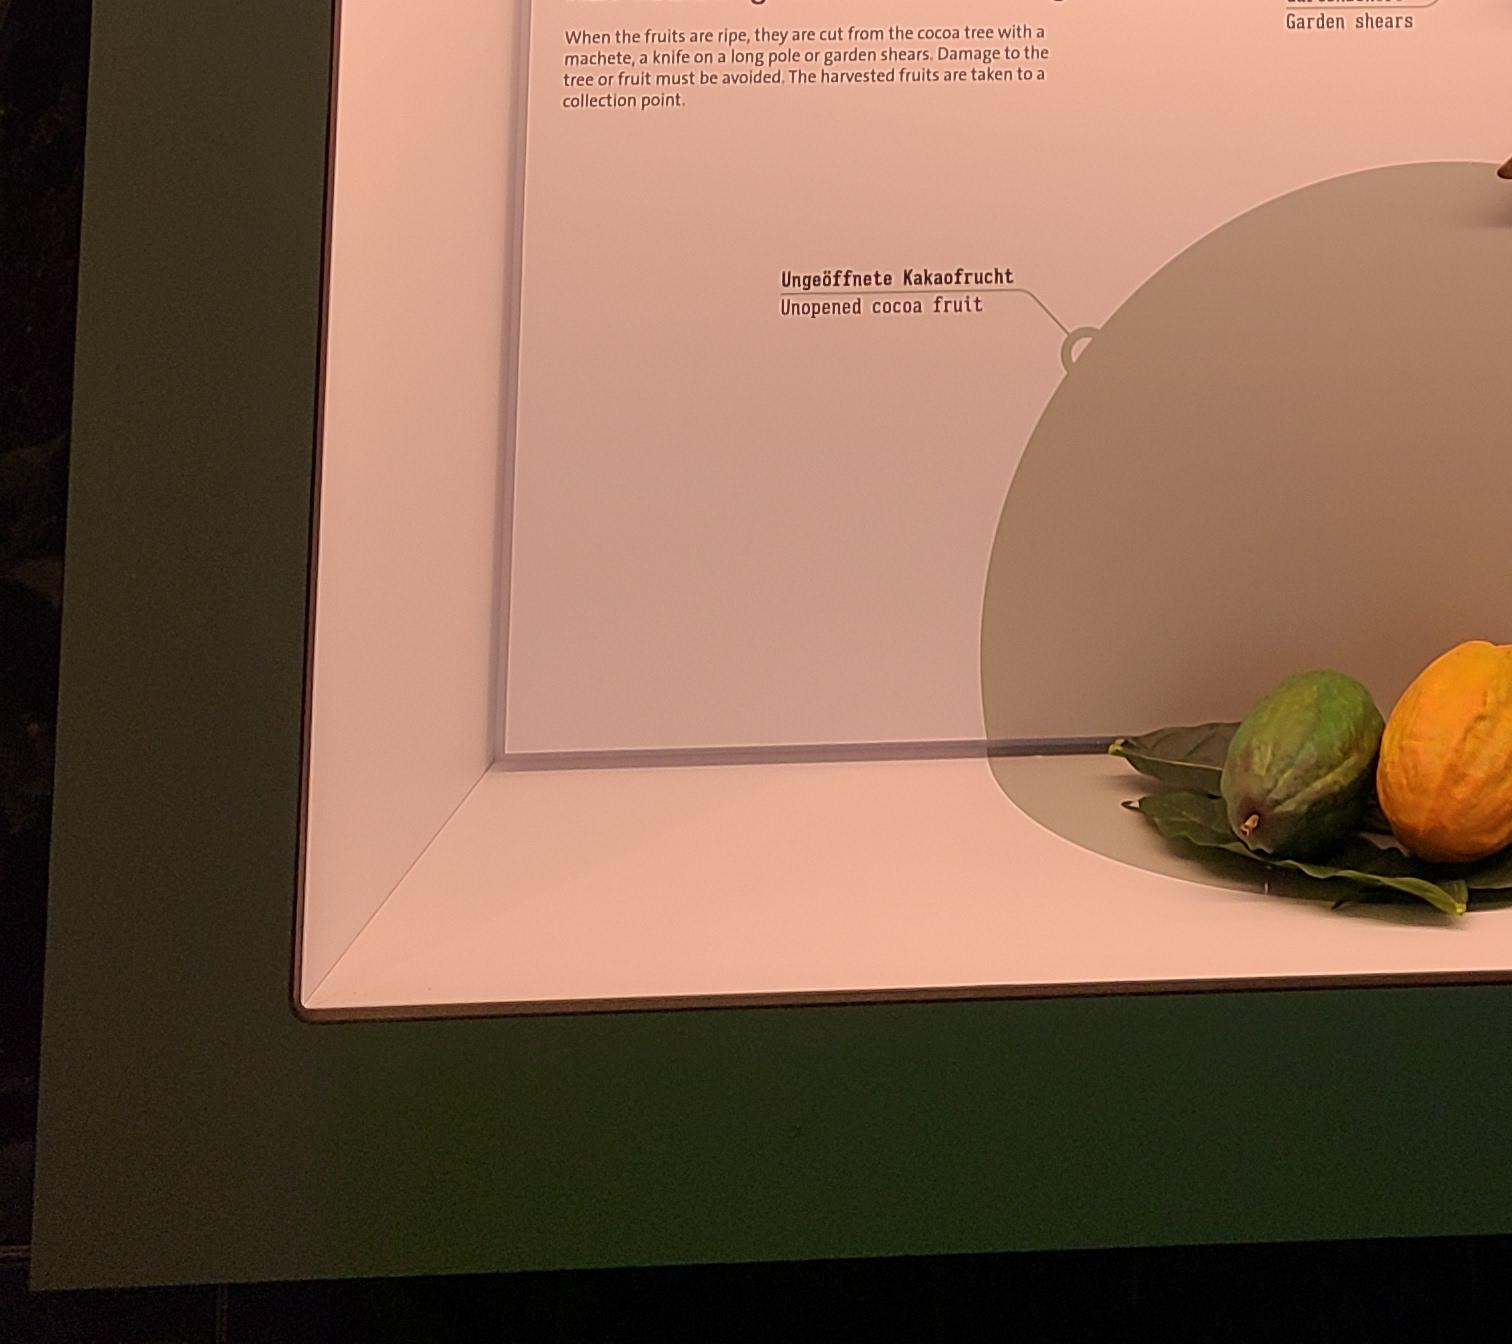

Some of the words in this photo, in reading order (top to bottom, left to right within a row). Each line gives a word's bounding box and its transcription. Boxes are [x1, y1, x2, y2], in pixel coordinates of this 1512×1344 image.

[1286, 13, 1345, 30] Garden
[1355, 12, 1413, 29] shears
[565, 30, 611, 45] When
[615, 29, 641, 44] the
[645, 28, 685, 44] fruits
[689, 32, 713, 43] are
[718, 28, 750, 47] ripe,
[754, 27, 789, 46] they
[792, 30, 815, 41] are
[819, 27, 843, 41] cut
[848, 26, 884, 41] from
[888, 25, 914, 40] the
[917, 29, 960, 40] cocoa
[964, 26, 994, 39] tree
[998, 24, 1032, 39] with
[1036, 28, 1044, 38] a
[564, 50, 635, 67] machete,
[639, 54, 648, 64] a
[653, 49, 690, 65] knife
[694, 53, 713, 64] on
[718, 53, 726, 63] a
[731, 48, 764, 67] long
[768, 48, 800, 67] pole
[804, 51, 820, 62] or
[824, 47, 876, 66] garden
[881, 47, 933, 61] shears.
[938, 47, 1001, 64] Damage
[1004, 46, 1020, 60] to
[1024, 45, 1049, 60] the
[563, 73, 594, 87] tree
[598, 75, 614, 86] or
[618, 71, 651, 86] fruit
[656, 72, 695, 86] must
[700, 70, 718, 85] be
[722, 69, 785, 84] avoided.
[788, 69, 816, 84] The
[821, 67, 895, 83] harvested
[899, 67, 939, 82] fruits
[944, 70, 967, 81] are
[971, 66, 1013, 81] taken
[1017, 67, 1033, 81] to
[1036, 69, 1045, 80] a
[563, 93, 636, 108] collection
[641, 92, 685, 111] point.
[782, 270, 892, 291] Ungeöffnete
[903, 267, 1014, 286] Kakaofrucht
[781, 297, 861, 319] Unopened
[872, 301, 922, 314] cocoa
[934, 295, 983, 313] fruit
